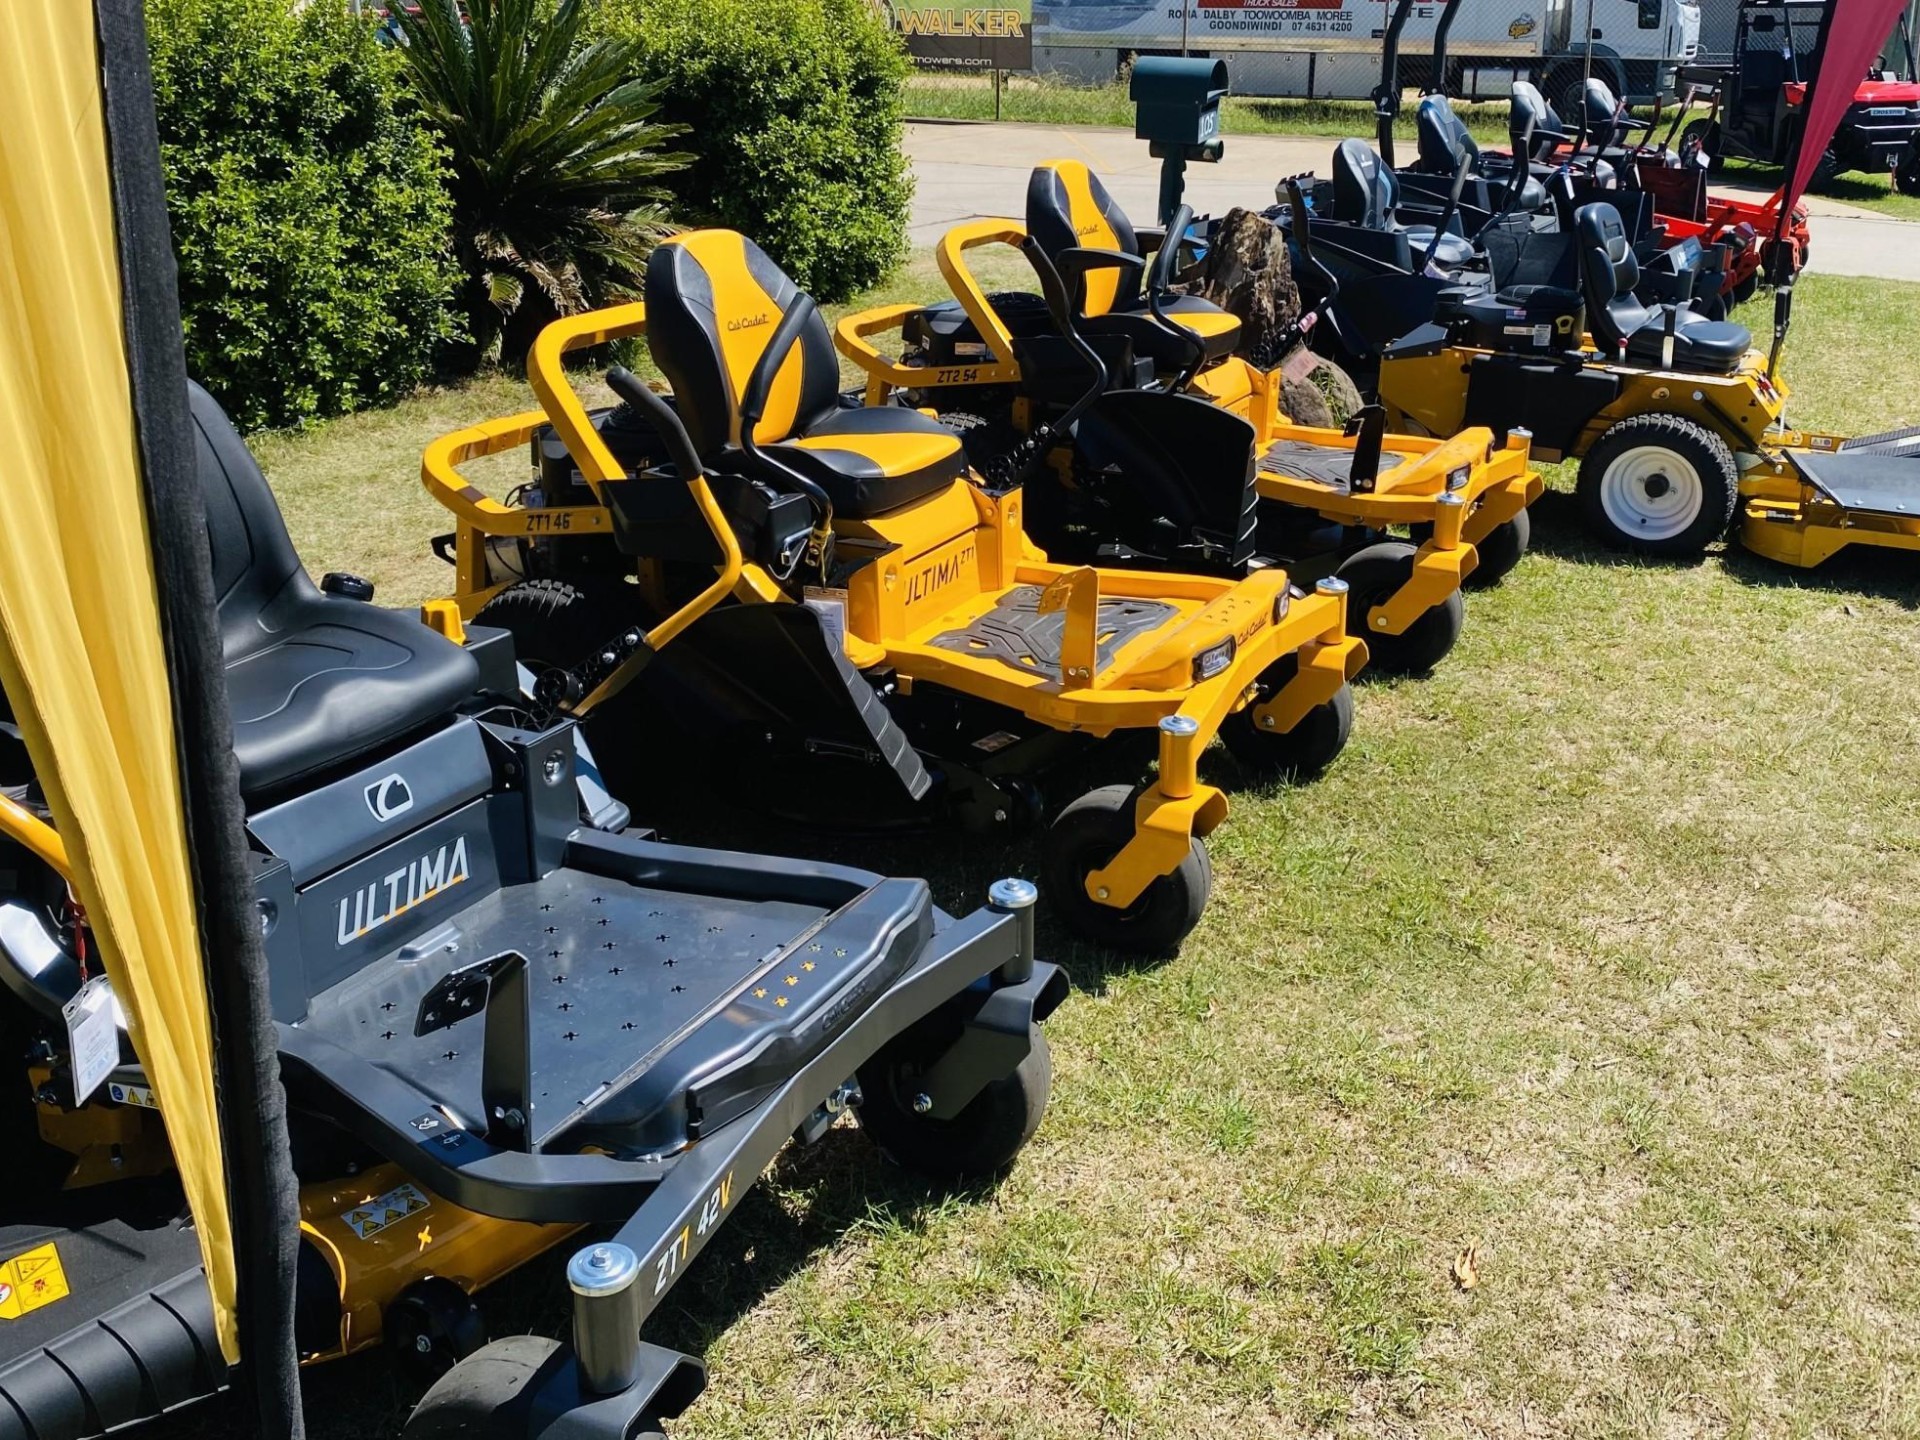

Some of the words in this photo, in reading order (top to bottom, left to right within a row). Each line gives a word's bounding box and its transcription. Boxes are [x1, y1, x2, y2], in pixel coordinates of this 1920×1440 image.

[899, 9, 1024, 37] WALKER
[1203, 10, 1237, 20] DALBY
[1243, 10, 1312, 21] TOOWOOMBA
[1316, 11, 1353, 21] MOREE
[1209, 20, 1283, 31] GOONDIWINDI
[1291, 22, 1303, 31] 07
[1305, 22, 1327, 32] 4631
[1329, 22, 1353, 32] 4200
[911, 55, 993, 66] mowers.com
[741, 313, 769, 328] Cadet
[937, 369, 961, 384] ZT2
[962, 368, 979, 382] 54
[526, 513, 551, 532] ZT1
[553, 511, 573, 530] 46
[337, 836, 470, 947] ULTIMA
[653, 1225, 690, 1297] ZT1
[696, 1169, 734, 1236] 42V
